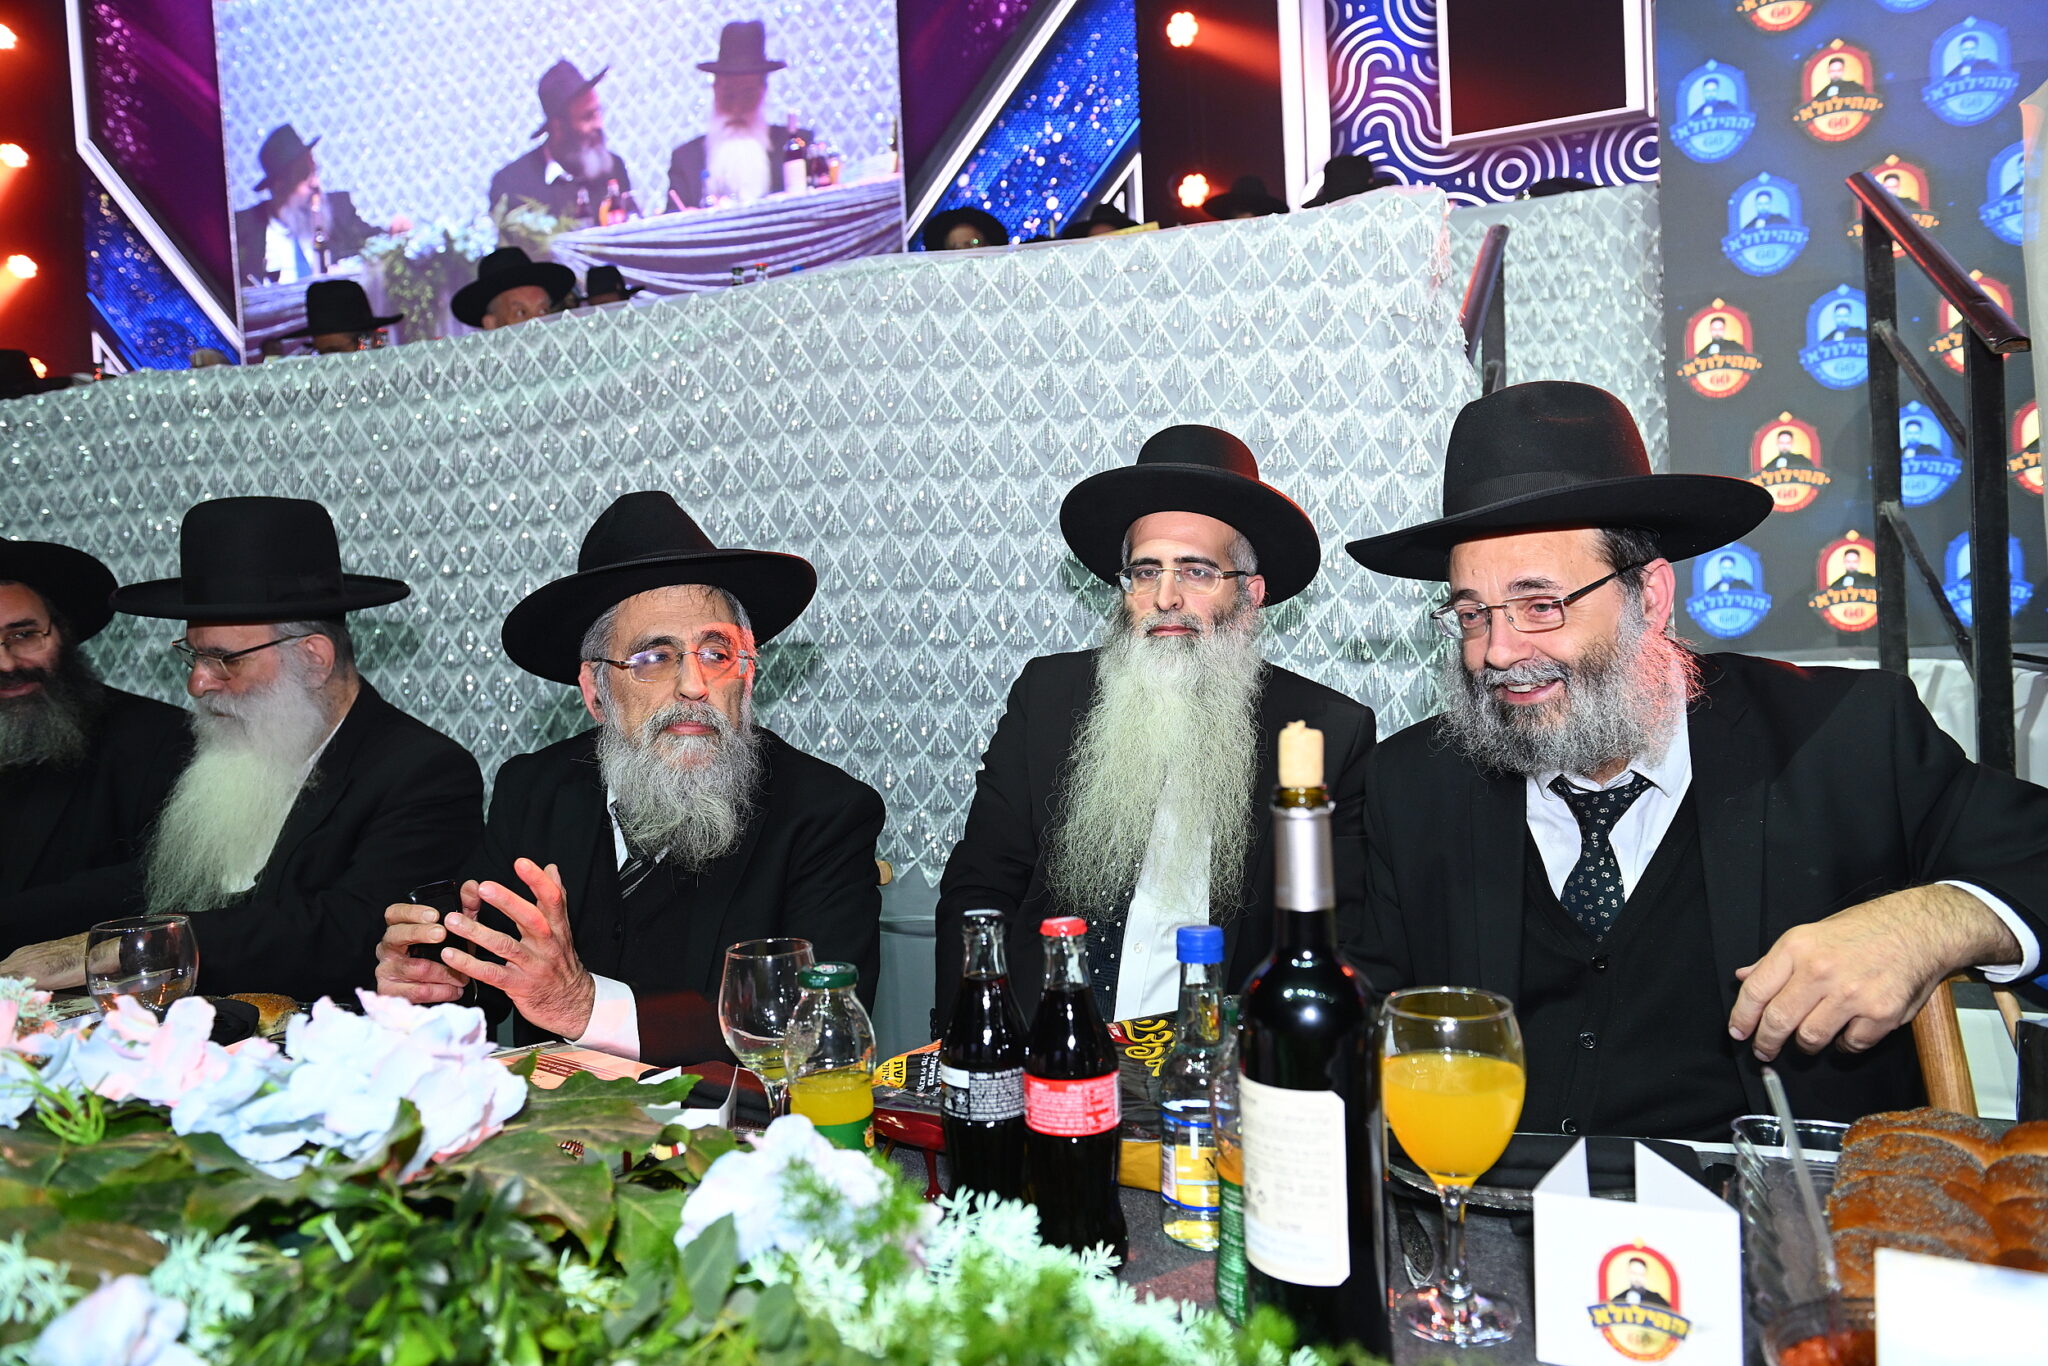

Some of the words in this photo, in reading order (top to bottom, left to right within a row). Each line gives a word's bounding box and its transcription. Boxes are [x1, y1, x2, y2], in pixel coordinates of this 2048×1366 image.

[1799, 96, 1879, 121] ההילולא
[1676, 116, 1751, 140] ההילולא
[1728, 229, 1804, 252] ההילולא
[1807, 342, 1867, 364] הילולא
[1683, 353, 1758, 377] ההילולא
[1902, 459, 1956, 476] ההילו
[1692, 592, 1766, 613] ההילולא
[1815, 586, 1877, 608] הילולא
